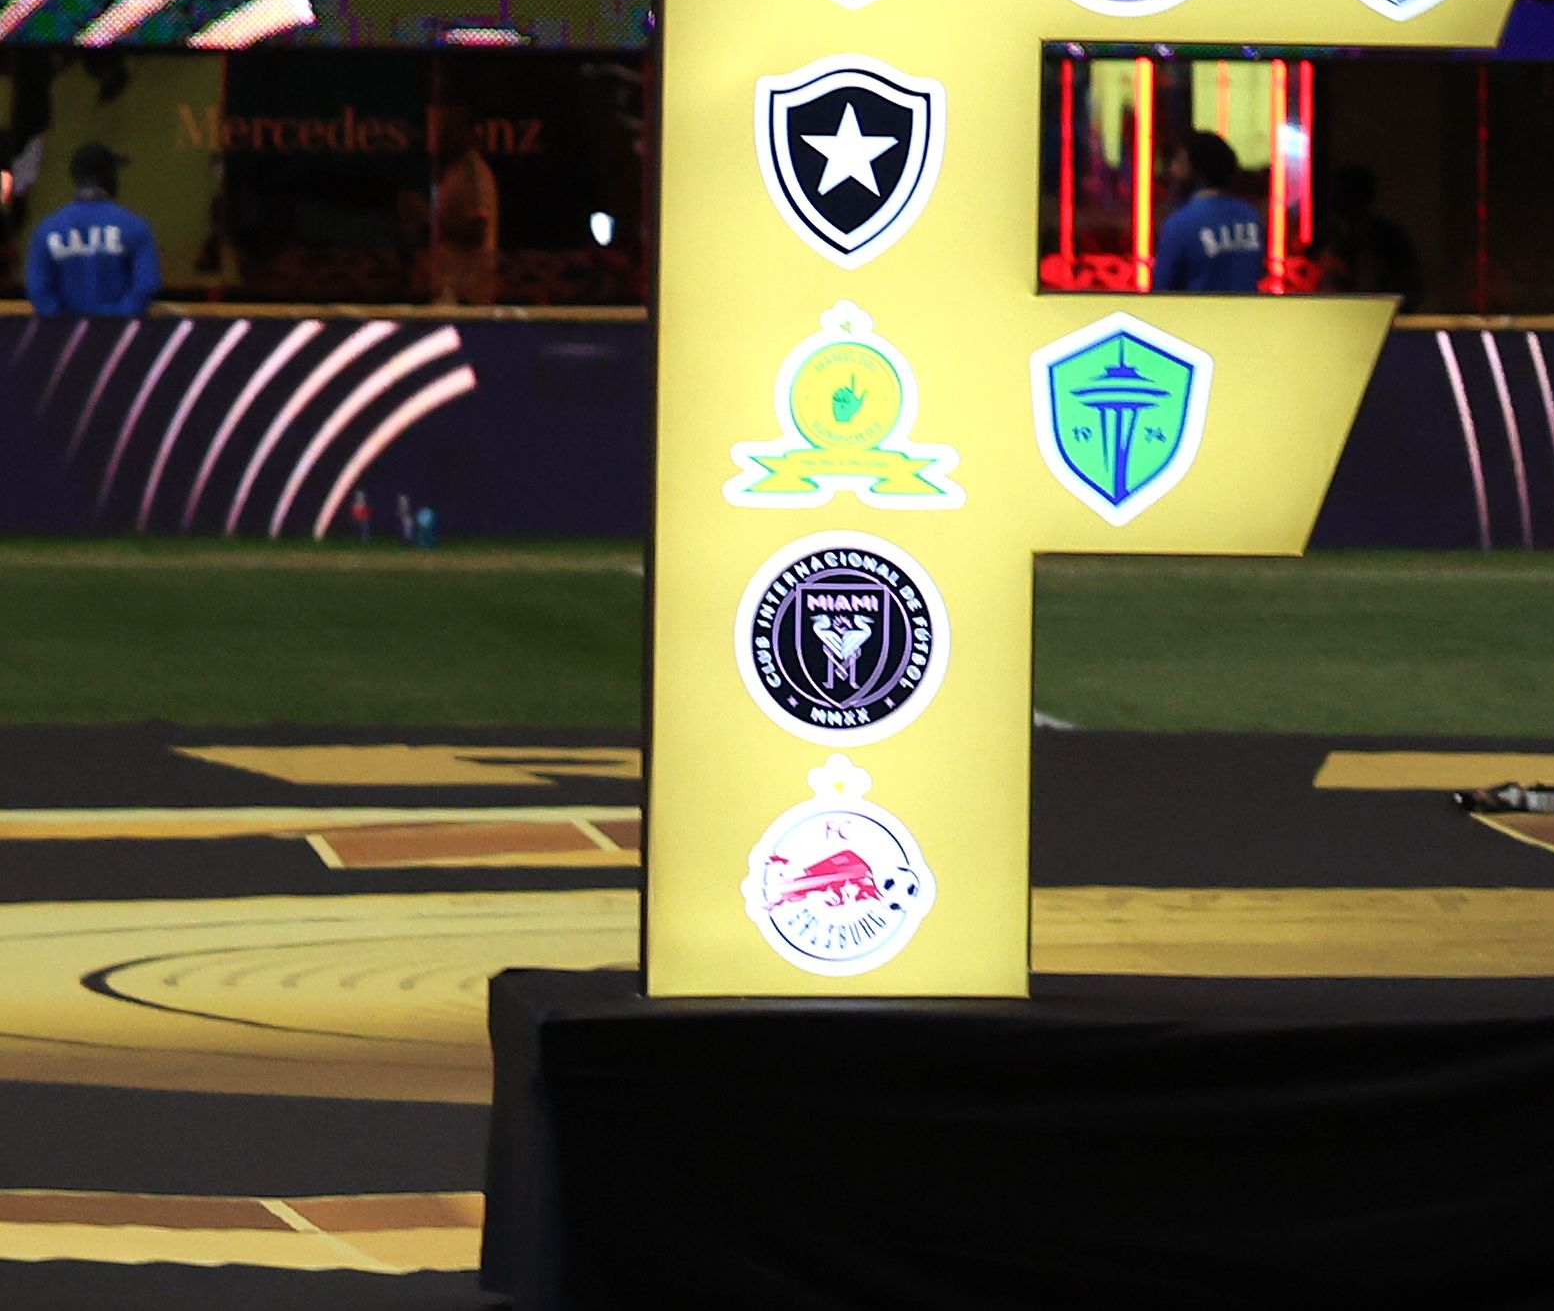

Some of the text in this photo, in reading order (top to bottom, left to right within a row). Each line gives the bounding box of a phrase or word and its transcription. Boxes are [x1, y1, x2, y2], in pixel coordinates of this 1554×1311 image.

[176, 103, 542, 153] Mercedes-nz
[757, 550, 899, 630] INTERNACIONAL
[806, 593, 880, 613] MIAMI
[898, 583, 922, 614] DE
[755, 635, 781, 689] CLUB
